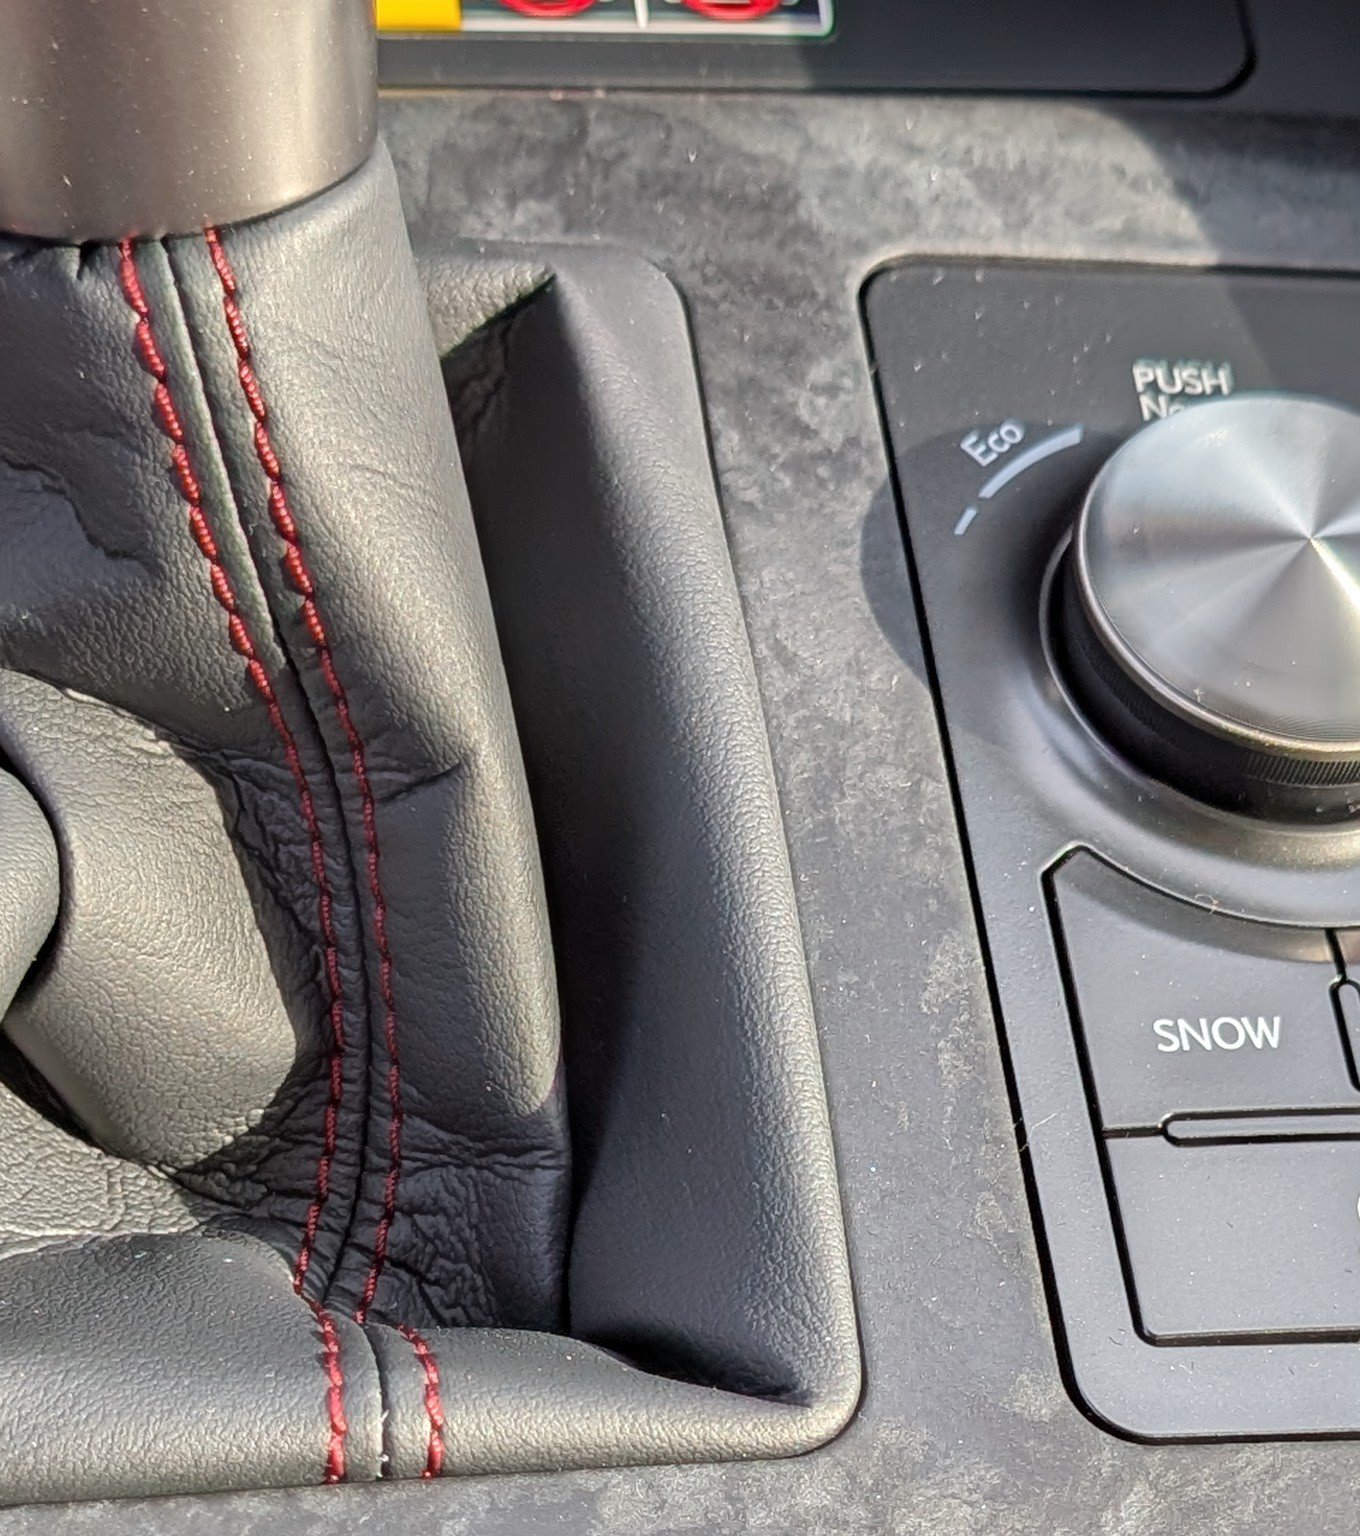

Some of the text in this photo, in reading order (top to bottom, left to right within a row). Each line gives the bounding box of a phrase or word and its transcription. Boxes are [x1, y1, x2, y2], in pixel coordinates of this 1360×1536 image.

[1132, 359, 1233, 395] PUSH
[960, 420, 1026, 467] Eco
[1152, 1015, 1282, 1052] SNOW
